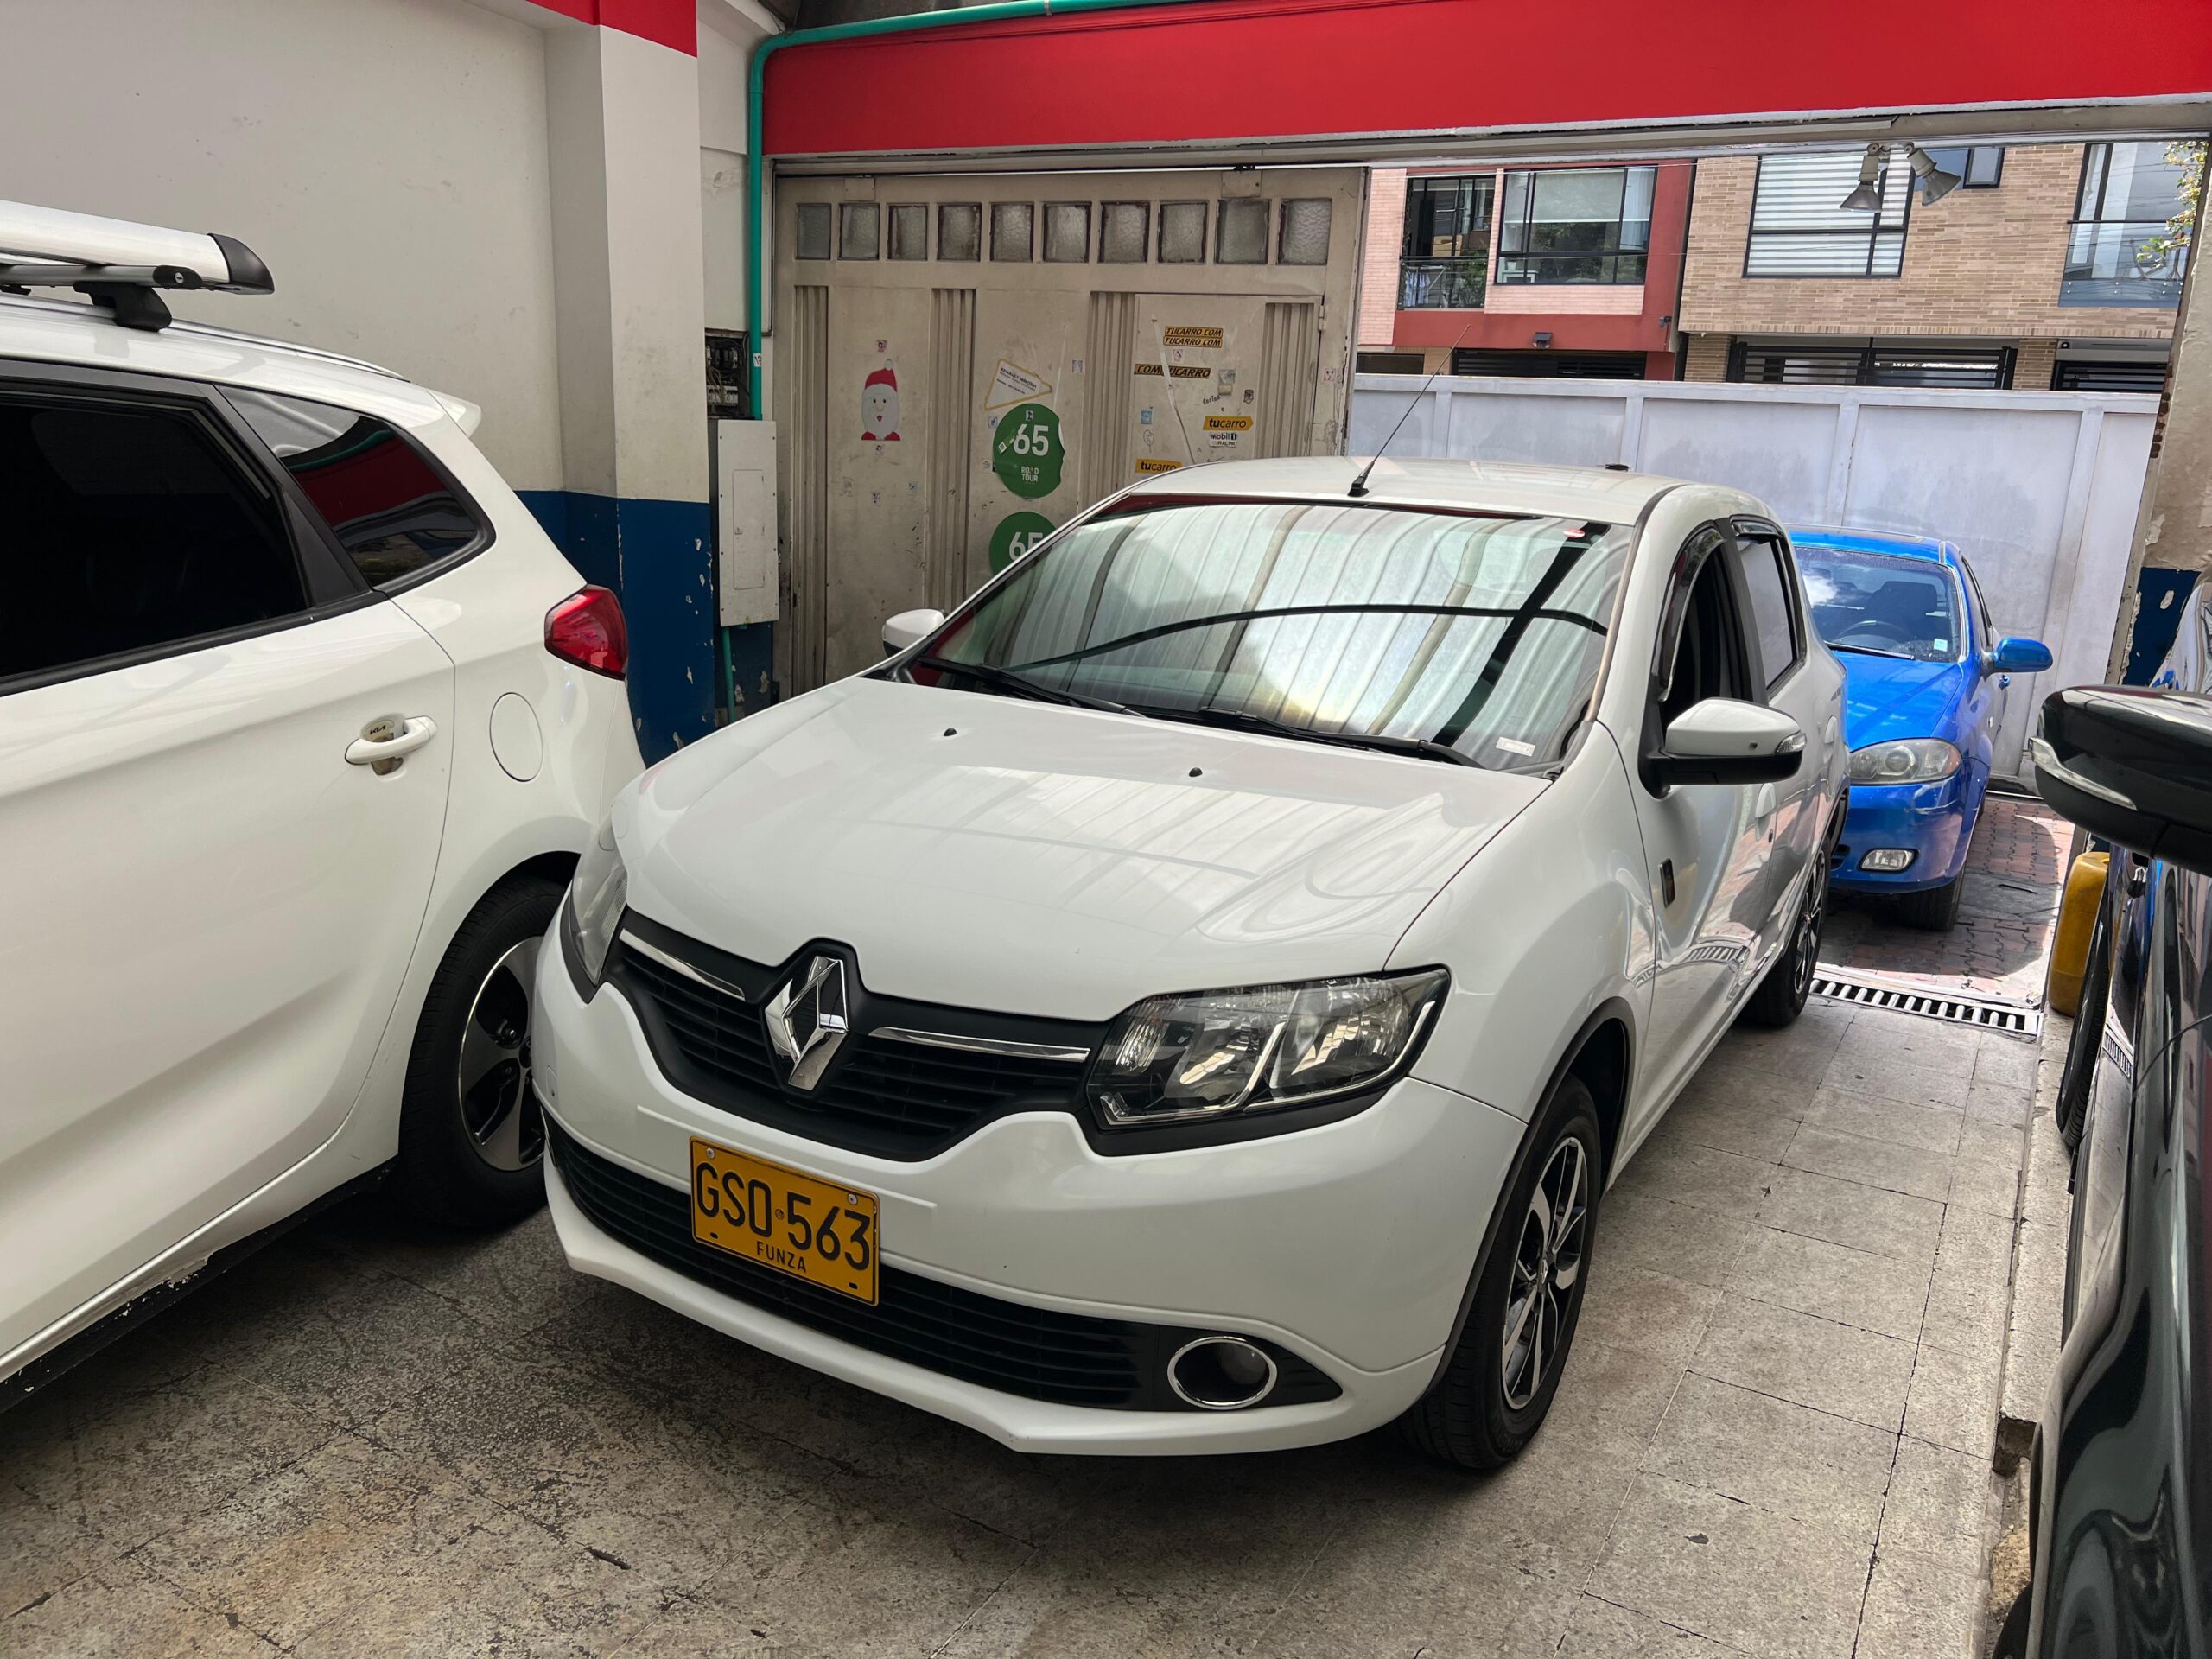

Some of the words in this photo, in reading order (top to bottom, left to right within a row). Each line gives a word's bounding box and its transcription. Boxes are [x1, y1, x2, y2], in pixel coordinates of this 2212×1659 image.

[1169, 366, 1211, 378] UCARRO
[1209, 418, 1247, 429] tucarro
[1013, 423, 1049, 456] 65
[1141, 461, 1177, 472] tucarro
[696, 1162, 772, 1238] GSO
[787, 1192, 871, 1271] 563
[756, 1240, 807, 1273] FUNZA
